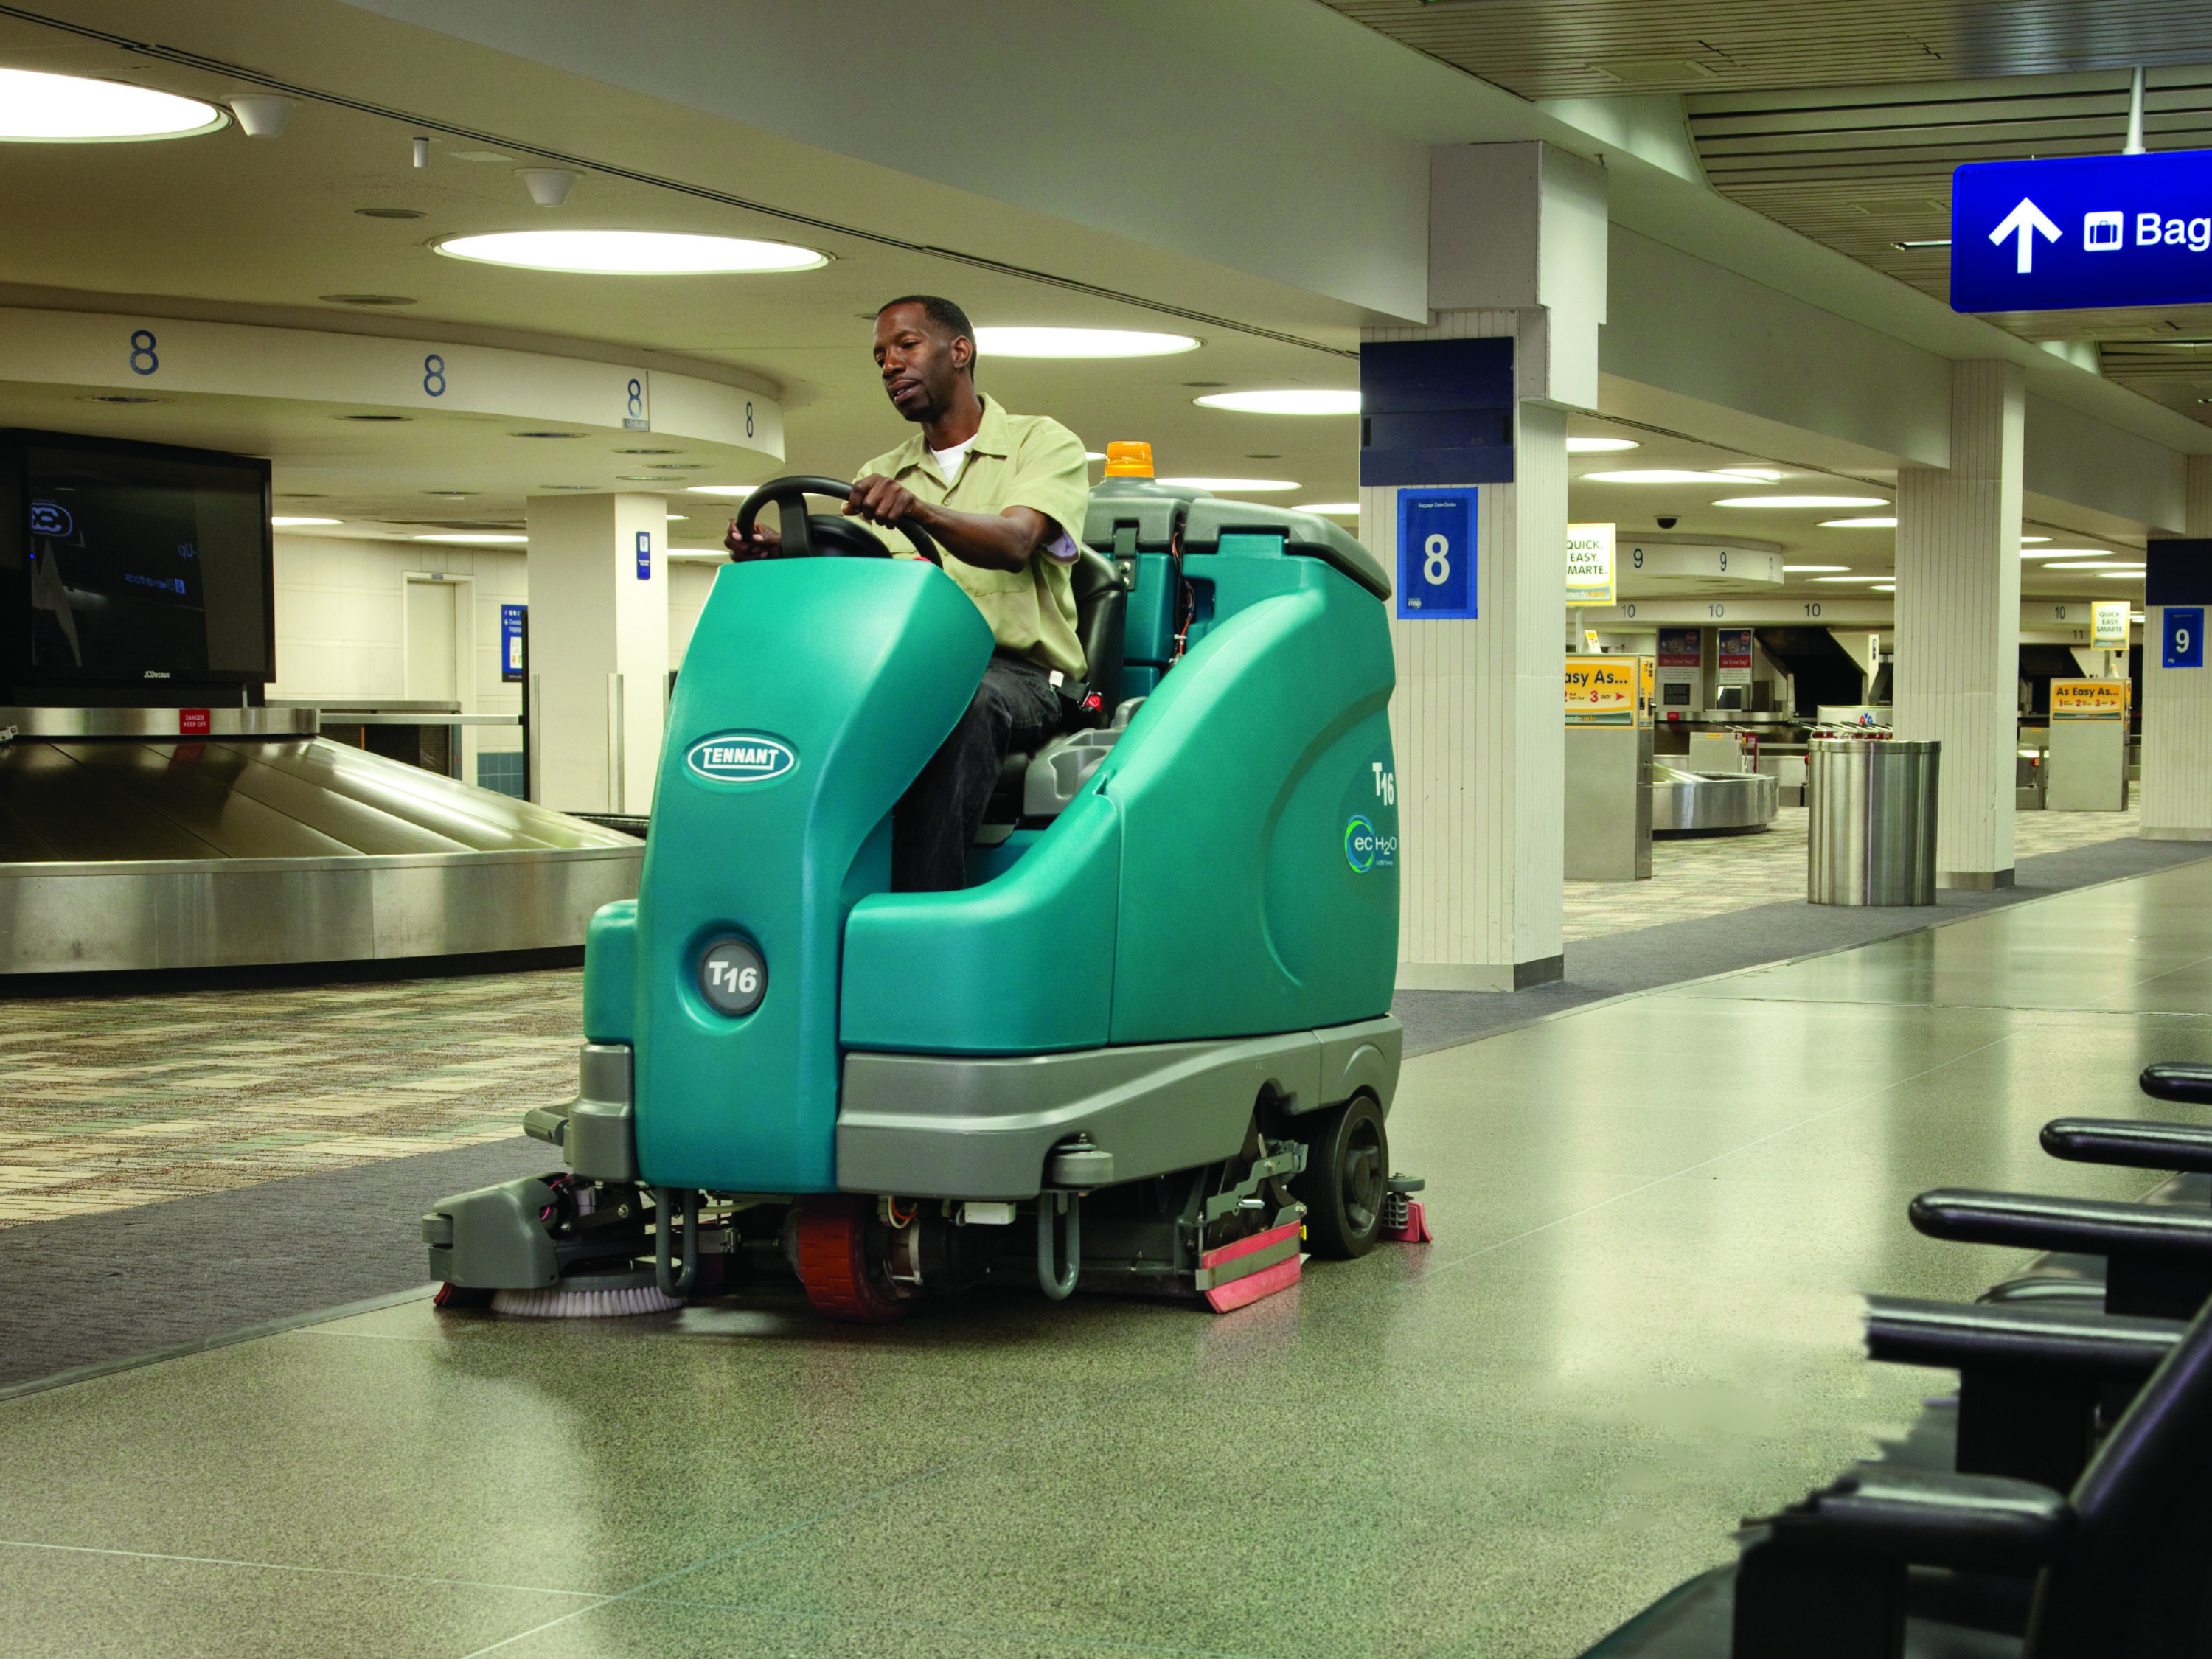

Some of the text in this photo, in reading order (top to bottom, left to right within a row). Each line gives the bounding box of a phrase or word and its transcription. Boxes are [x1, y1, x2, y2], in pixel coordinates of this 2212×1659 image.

[130, 330, 159, 376] 8
[423, 354, 446, 397] 8
[627, 378, 643, 419] 8
[746, 400, 754, 439] 8
[1566, 540, 1604, 549] QUICK.
[1423, 533, 1450, 585] 8
[1570, 553, 1599, 562] EASY.
[1633, 548, 1644, 568] 9
[1719, 552, 1728, 571] 9
[1567, 565, 1608, 574] MARTE.
[1621, 605, 1636, 618] 10
[1708, 604, 1725, 618] 10
[1805, 603, 1821, 617] 10
[2055, 605, 2066, 620] 10
[2073, 630, 2084, 639] 11
[2176, 628, 2190, 653] 9
[1565, 669, 1628, 687] asy As...
[1590, 690, 1599, 703] 3
[2056, 687, 2070, 696] As
[2073, 687, 2095, 698] Easy
[2059, 699, 2062, 707] 1
[2076, 699, 2081, 707] 2
[2095, 699, 2101, 707] 3
[703, 748, 779, 770] TENNANT
[1372, 762, 1394, 806] T16
[709, 961, 757, 993] T16
